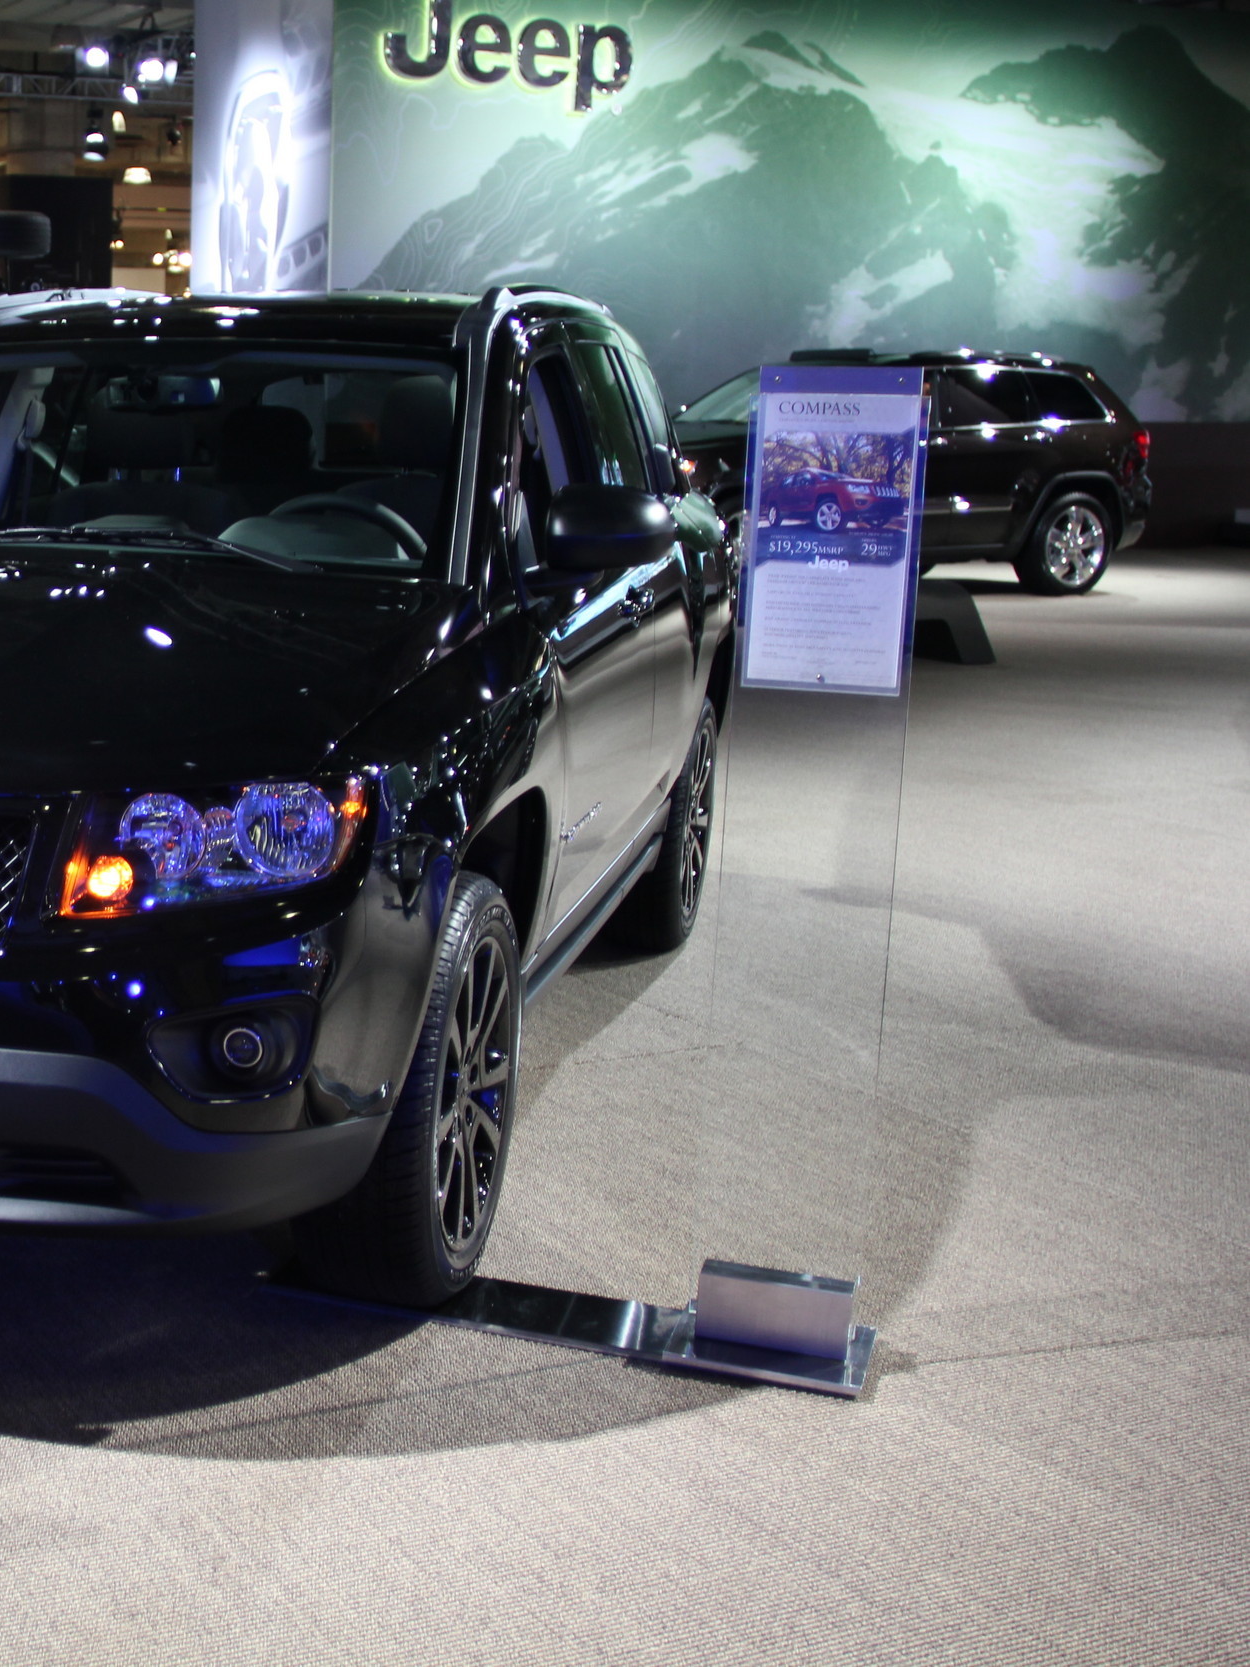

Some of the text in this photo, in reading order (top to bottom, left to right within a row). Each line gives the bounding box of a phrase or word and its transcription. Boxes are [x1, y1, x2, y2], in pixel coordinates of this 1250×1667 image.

[383, 0, 633, 112] Jeep
[778, 400, 861, 417] COMPASS
[769, 540, 819, 555] $19,295
[861, 543, 877, 556] 29
[808, 555, 850, 573] Jeep
